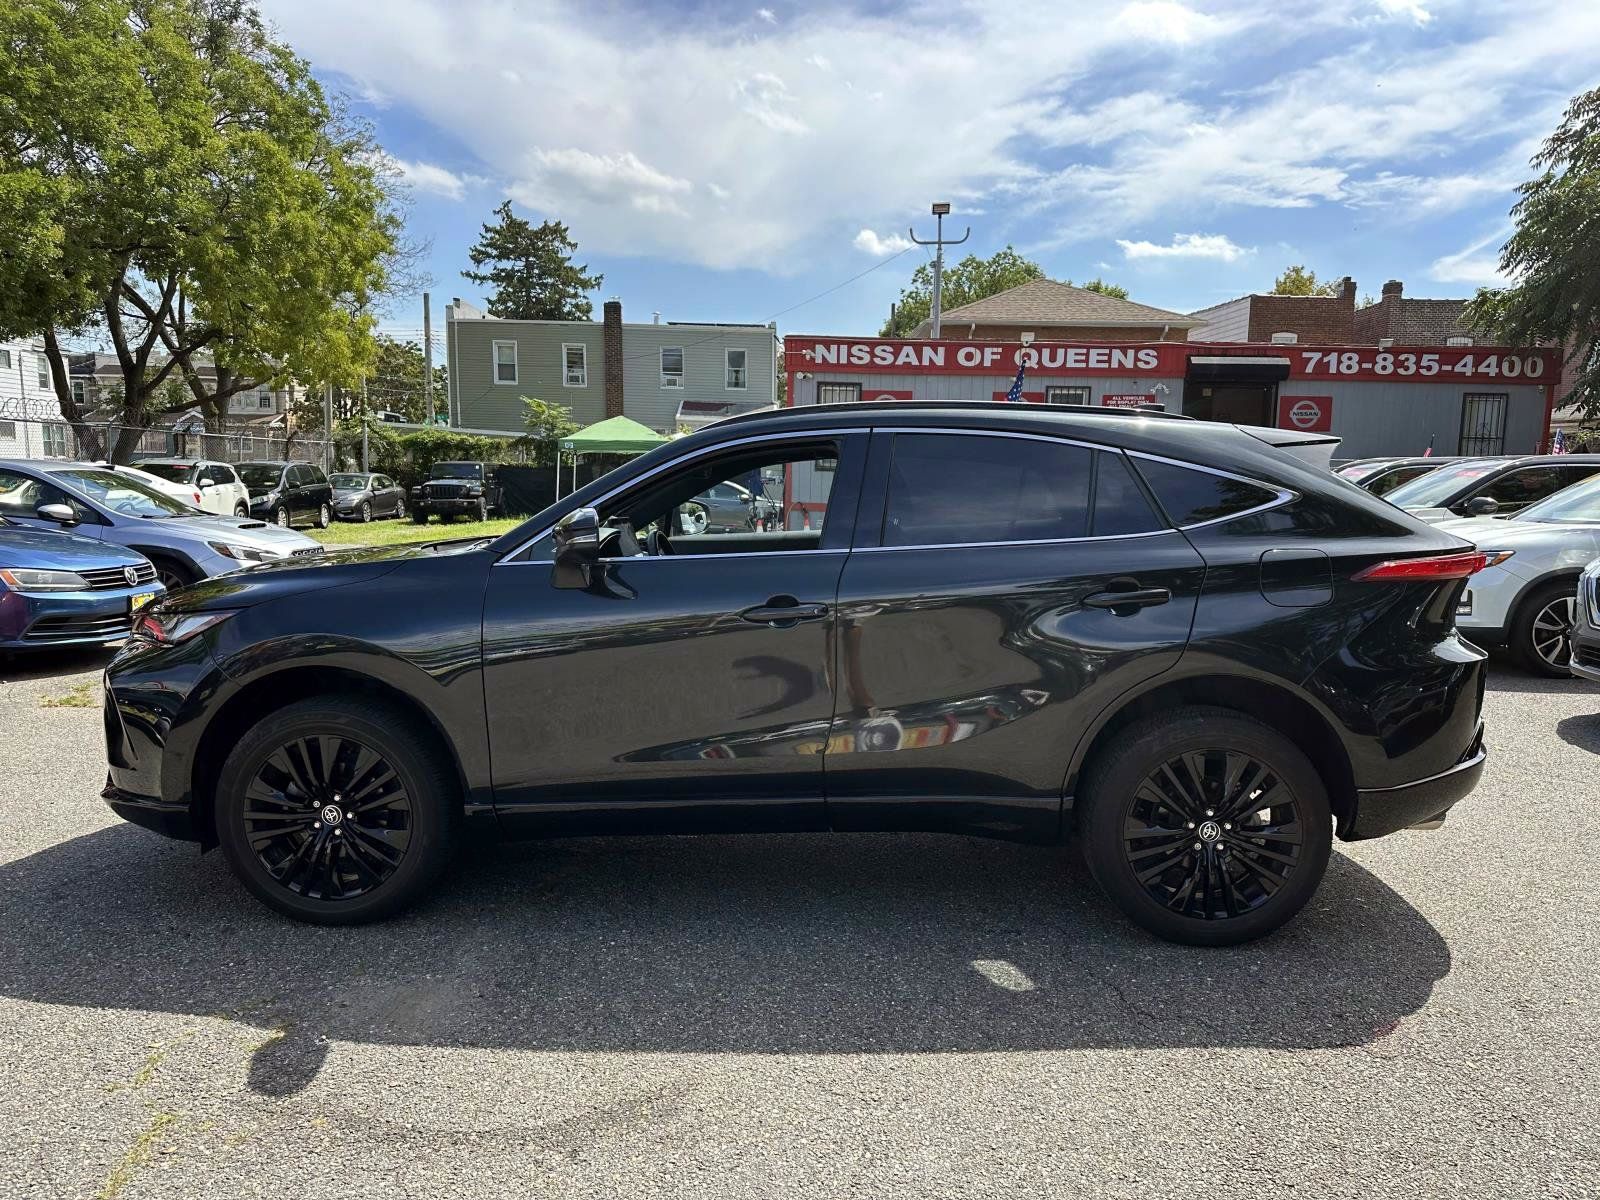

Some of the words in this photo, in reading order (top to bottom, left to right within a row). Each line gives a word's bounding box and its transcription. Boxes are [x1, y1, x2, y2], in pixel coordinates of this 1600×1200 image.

[814, 344, 945, 366] NISSAN
[956, 346, 1002, 367] OF
[1014, 347, 1158, 370] QUEENS
[1302, 351, 1544, 378] 718-835-4400
